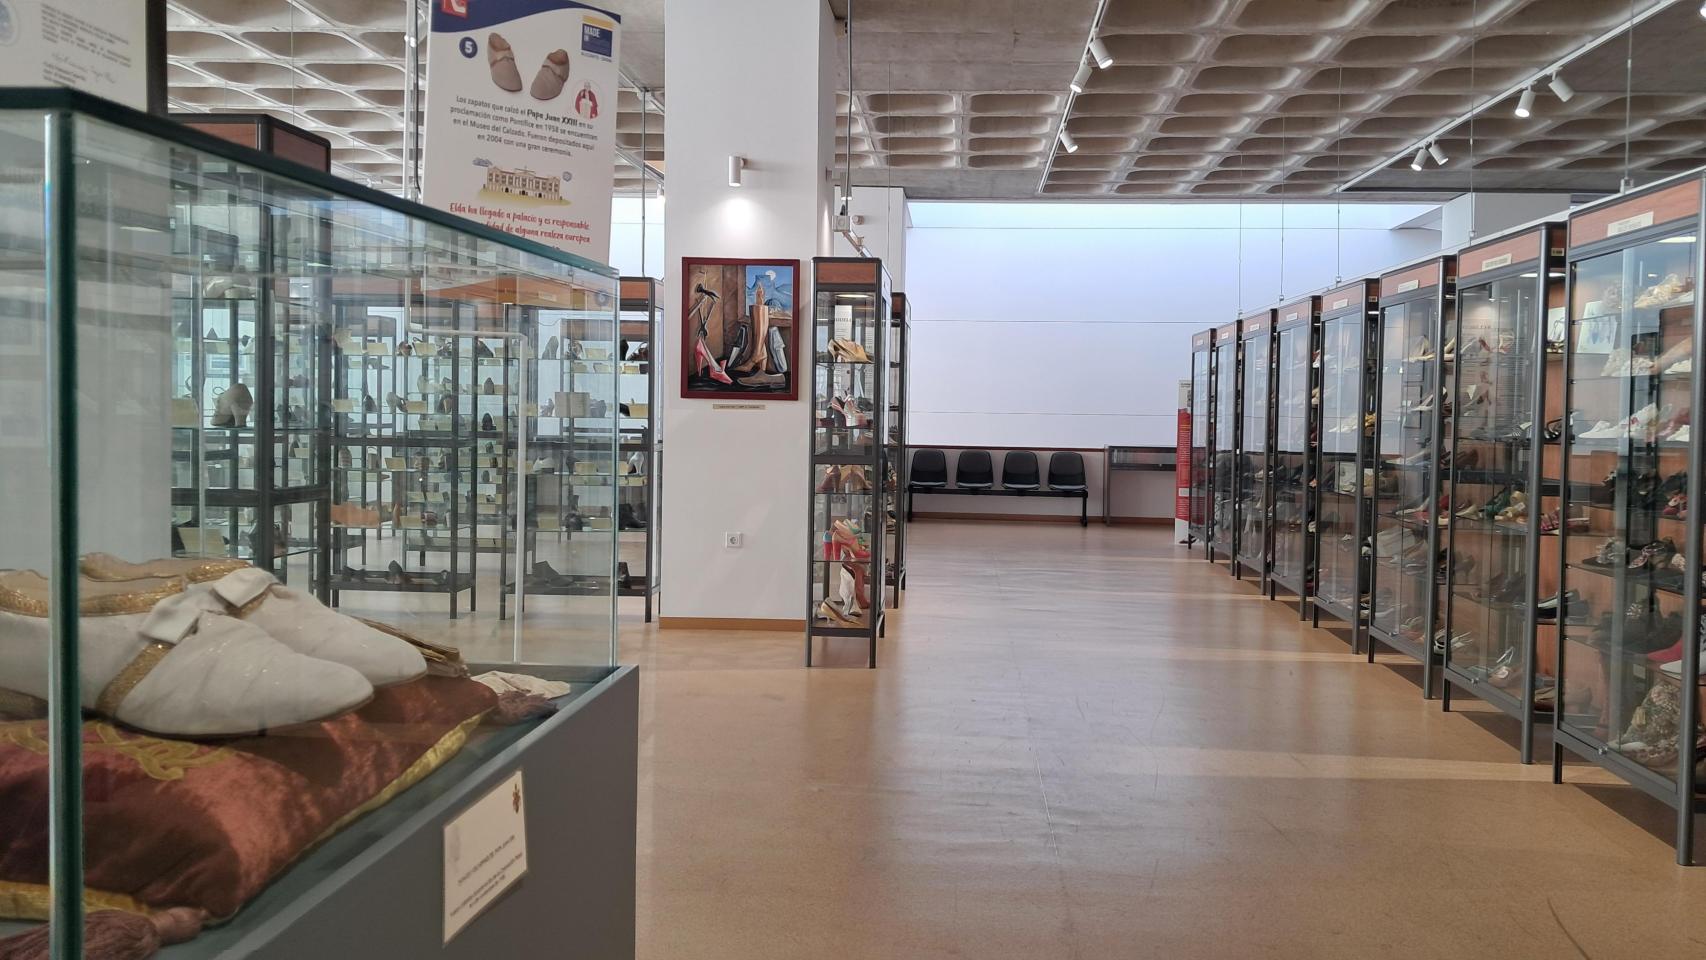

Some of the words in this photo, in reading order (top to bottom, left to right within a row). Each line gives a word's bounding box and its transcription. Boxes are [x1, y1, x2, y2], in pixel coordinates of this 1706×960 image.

[464, 41, 473, 54] 5
[450, 106, 491, 119] proclamación
[492, 115, 508, 123] como
[545, 124, 559, 133] 1958
[456, 96, 466, 104] Los
[468, 99, 490, 109] zapatos
[527, 109, 543, 120] Papa
[545, 113, 560, 122] Juan
[561, 116, 578, 126] XXIII
[470, 120, 490, 130] Museo
[486, 134, 502, 143] 2004
[528, 143, 541, 151] gran
[449, 202, 465, 213] Elda
[468, 204, 477, 214] ha
[479, 206, 505, 219] llegado
[512, 211, 537, 223] palacio
[538, 217, 543, 226] y
[552, 219, 590, 230] responsable
[505, 224, 513, 232] de
[514, 225, 539, 237] alguna
[540, 230, 564, 239] realeza
[565, 234, 590, 245] europea
